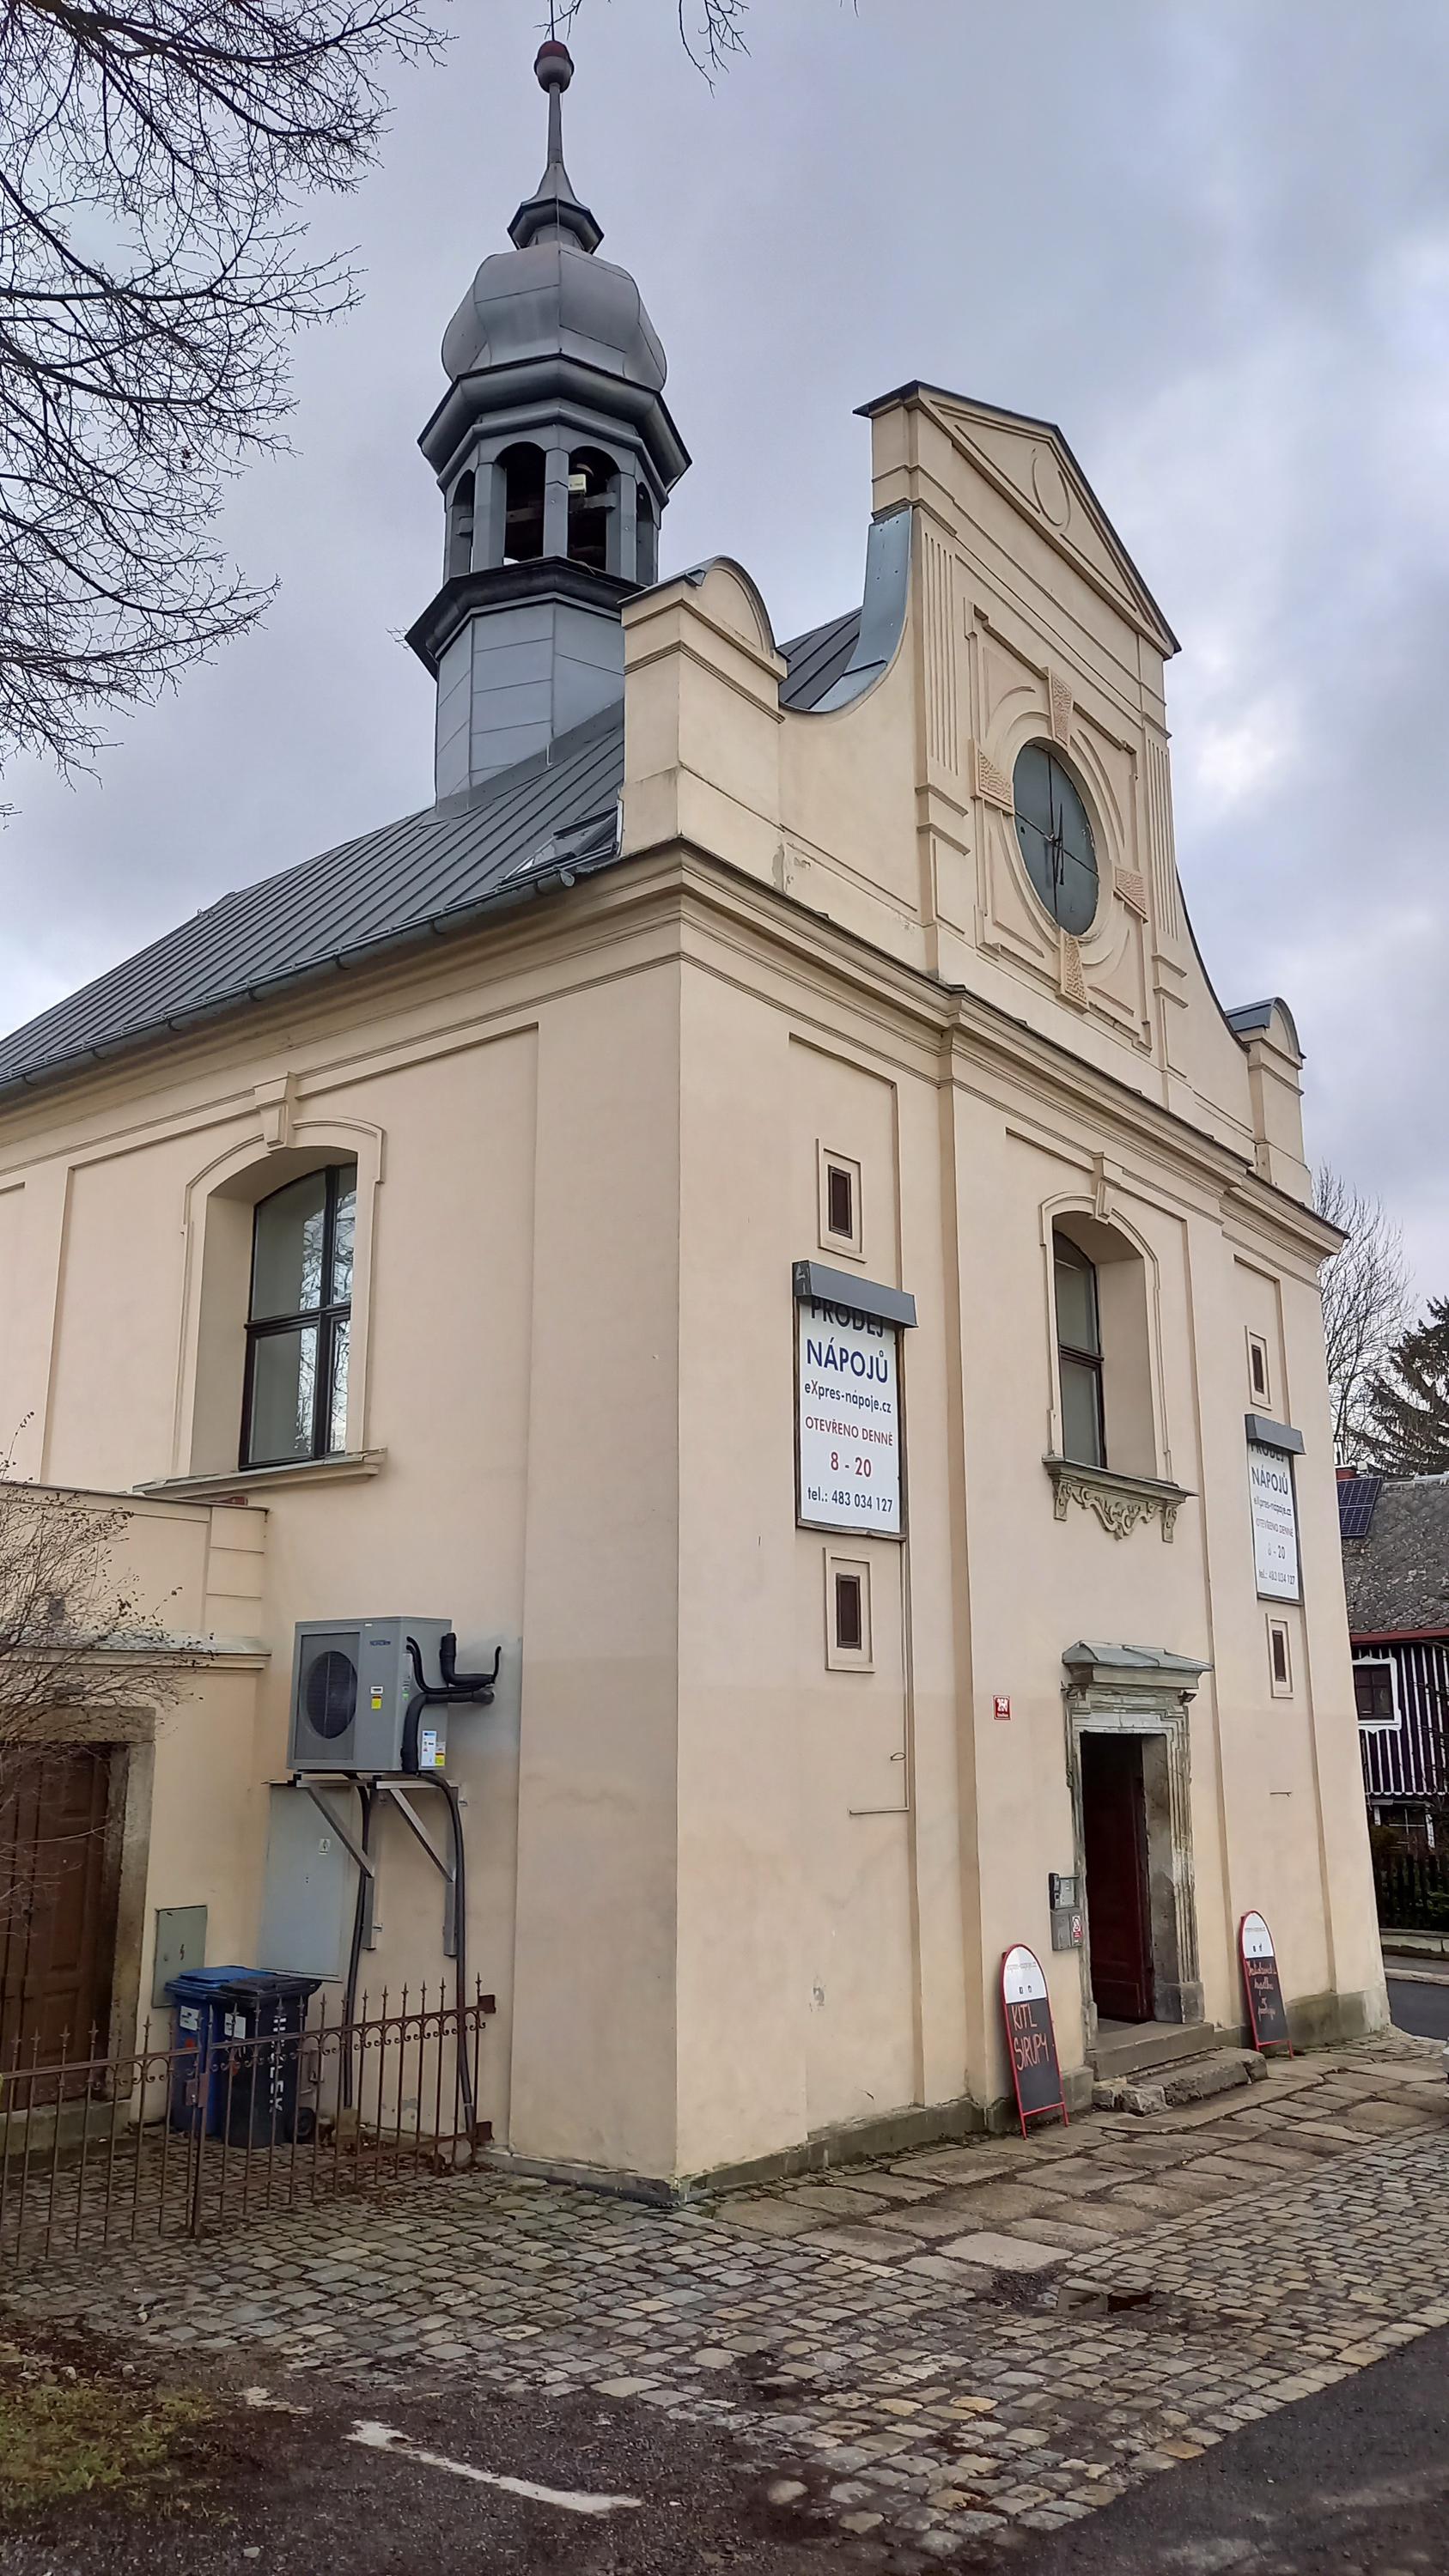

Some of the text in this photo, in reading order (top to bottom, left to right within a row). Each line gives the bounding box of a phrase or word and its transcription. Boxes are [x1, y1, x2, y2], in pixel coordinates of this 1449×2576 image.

[811, 1297, 884, 1338] PRODEJ
[807, 1337, 888, 1383] NÁPOJŮ
[804, 1379, 892, 1413] eXpres-nápoje.cz
[805, 1416, 859, 1439] OTEVŘENO
[831, 1451, 839, 1471] 8
[855, 1456, 872, 1478] 20
[807, 1486, 893, 1513] tel.: 483 034 127
[1011, 2003, 1038, 2032] KITL
[1014, 2032, 1050, 2071] SIRUPY
